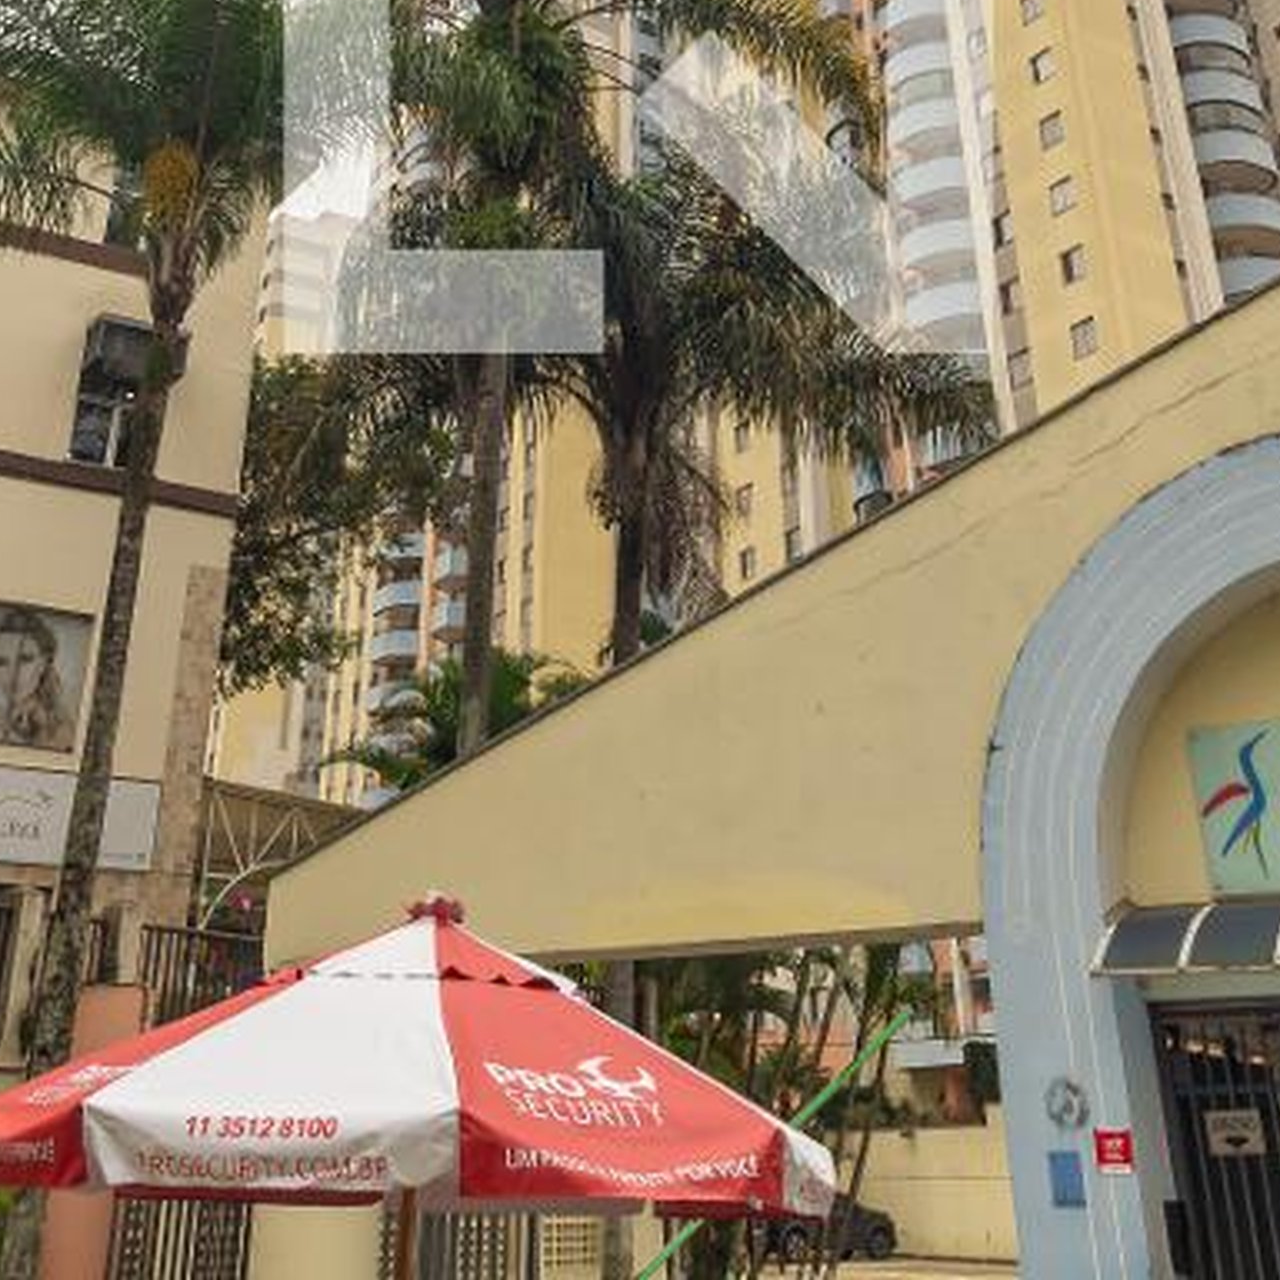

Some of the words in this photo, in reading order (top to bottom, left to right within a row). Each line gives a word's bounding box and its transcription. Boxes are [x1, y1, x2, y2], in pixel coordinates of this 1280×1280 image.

[483, 1061, 586, 1098] PRO
[505, 1088, 664, 1128] SECURITY
[187, 1116, 210, 1136] 11
[218, 1116, 273, 1138] 3512
[279, 1116, 338, 1138] 8100
